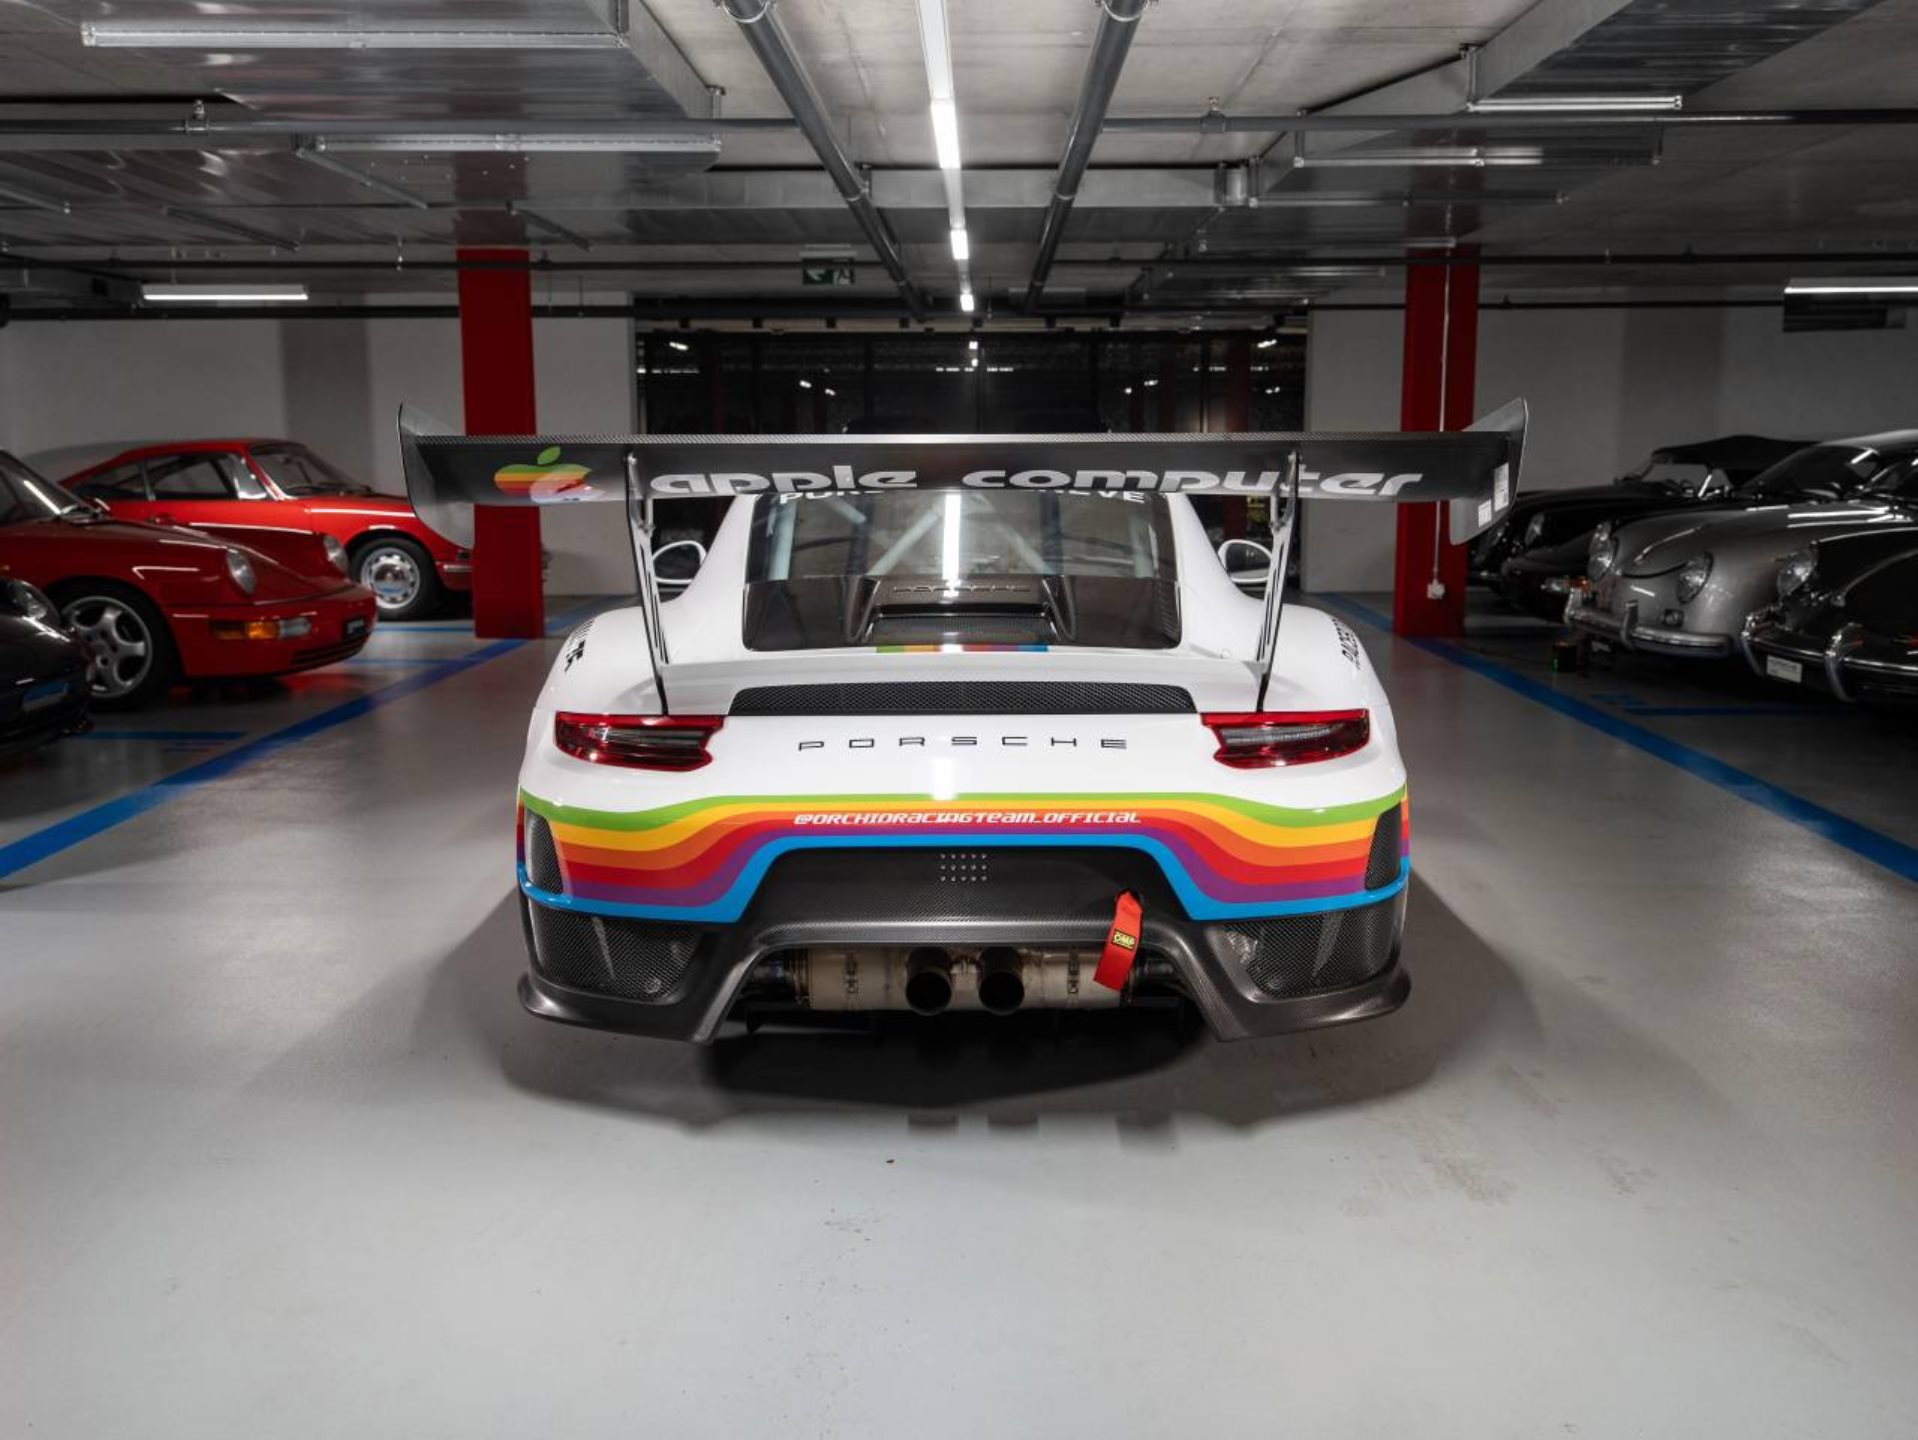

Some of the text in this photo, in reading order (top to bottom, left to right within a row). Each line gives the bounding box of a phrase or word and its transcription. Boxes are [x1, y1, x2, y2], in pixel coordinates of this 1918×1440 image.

[650, 464, 1423, 495] apple computer
[798, 736, 1127, 751] PORSCHE
